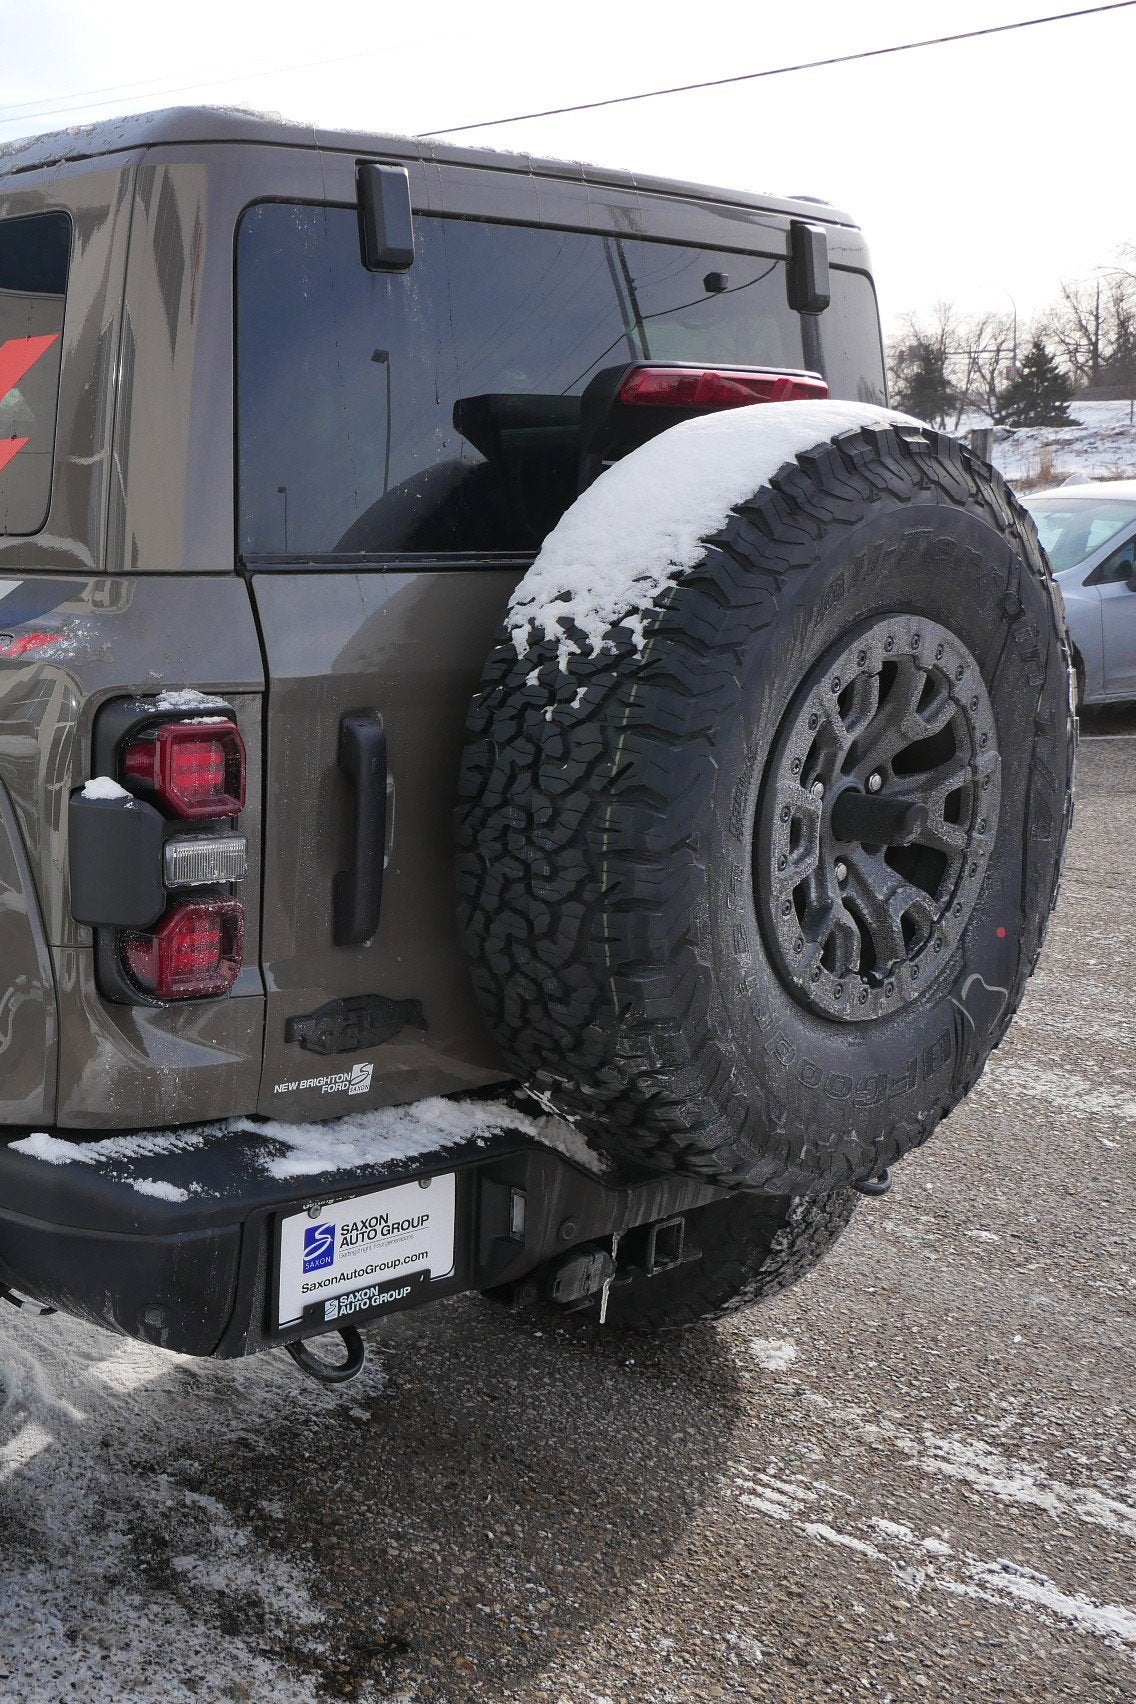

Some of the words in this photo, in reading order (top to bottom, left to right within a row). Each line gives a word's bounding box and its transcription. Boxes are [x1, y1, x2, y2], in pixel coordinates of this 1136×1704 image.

[274, 1081, 299, 1093] NEW
[300, 1072, 351, 1089] BRIGHTON
[321, 1082, 349, 1094] FORD
[349, 1084, 370, 1093] SAXON
[340, 1213, 389, 1236] SAXON
[340, 1229, 378, 1249] AUTO
[381, 1214, 430, 1237] GROUP
[301, 1250, 429, 1294] SaxonAutoGroup.com
[305, 1256, 331, 1270] SAXON
[338, 1300, 370, 1317] AUTO
[371, 1286, 412, 1306] GROUP
[339, 1286, 379, 1306] SAXON
